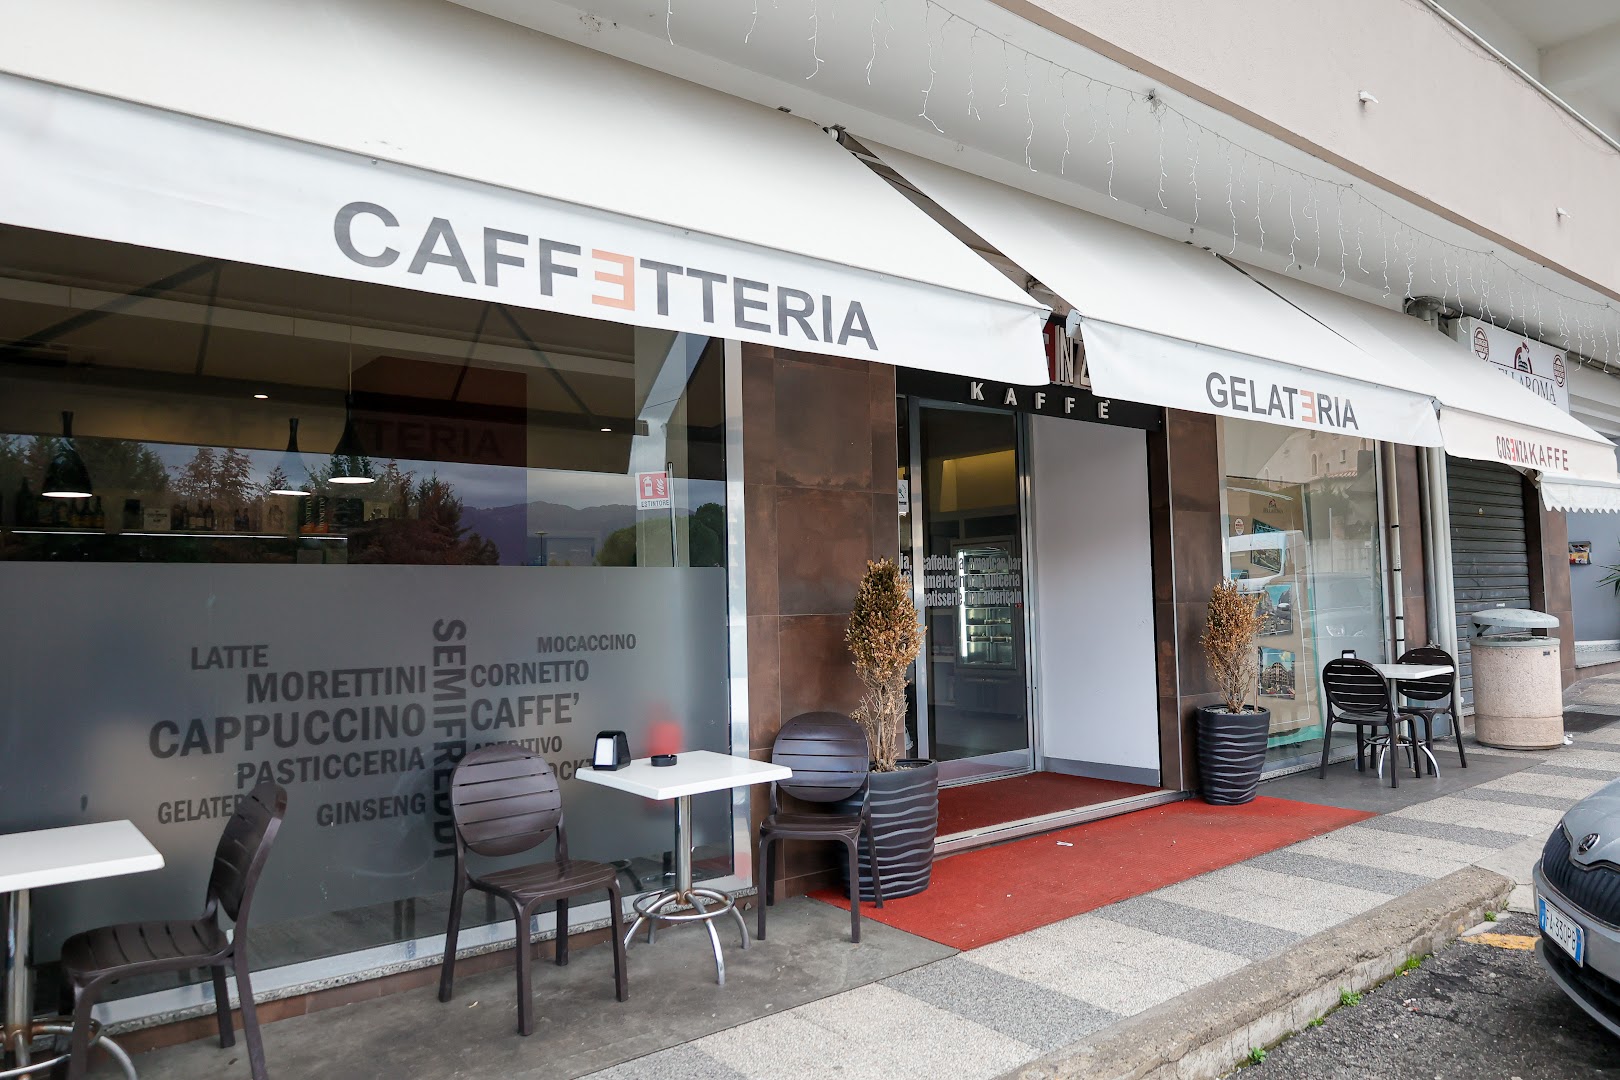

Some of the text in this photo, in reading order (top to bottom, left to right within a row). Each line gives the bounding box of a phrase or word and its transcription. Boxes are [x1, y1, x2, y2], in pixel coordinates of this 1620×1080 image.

[333, 201, 879, 350] CAFFETTERIA
[1206, 371, 1360, 430] GELATERIA
[641, 500, 669, 508] ESTINTORE
[190, 644, 269, 671] LATTE
[536, 632, 637, 655] MOCACCINO
[246, 665, 427, 704] MORETTINI
[470, 659, 590, 688] CORNETTO
[148, 703, 426, 760] CAPPUCCINO
[236, 745, 426, 790] PASTICCERIA
[316, 792, 427, 828] GINSENG
